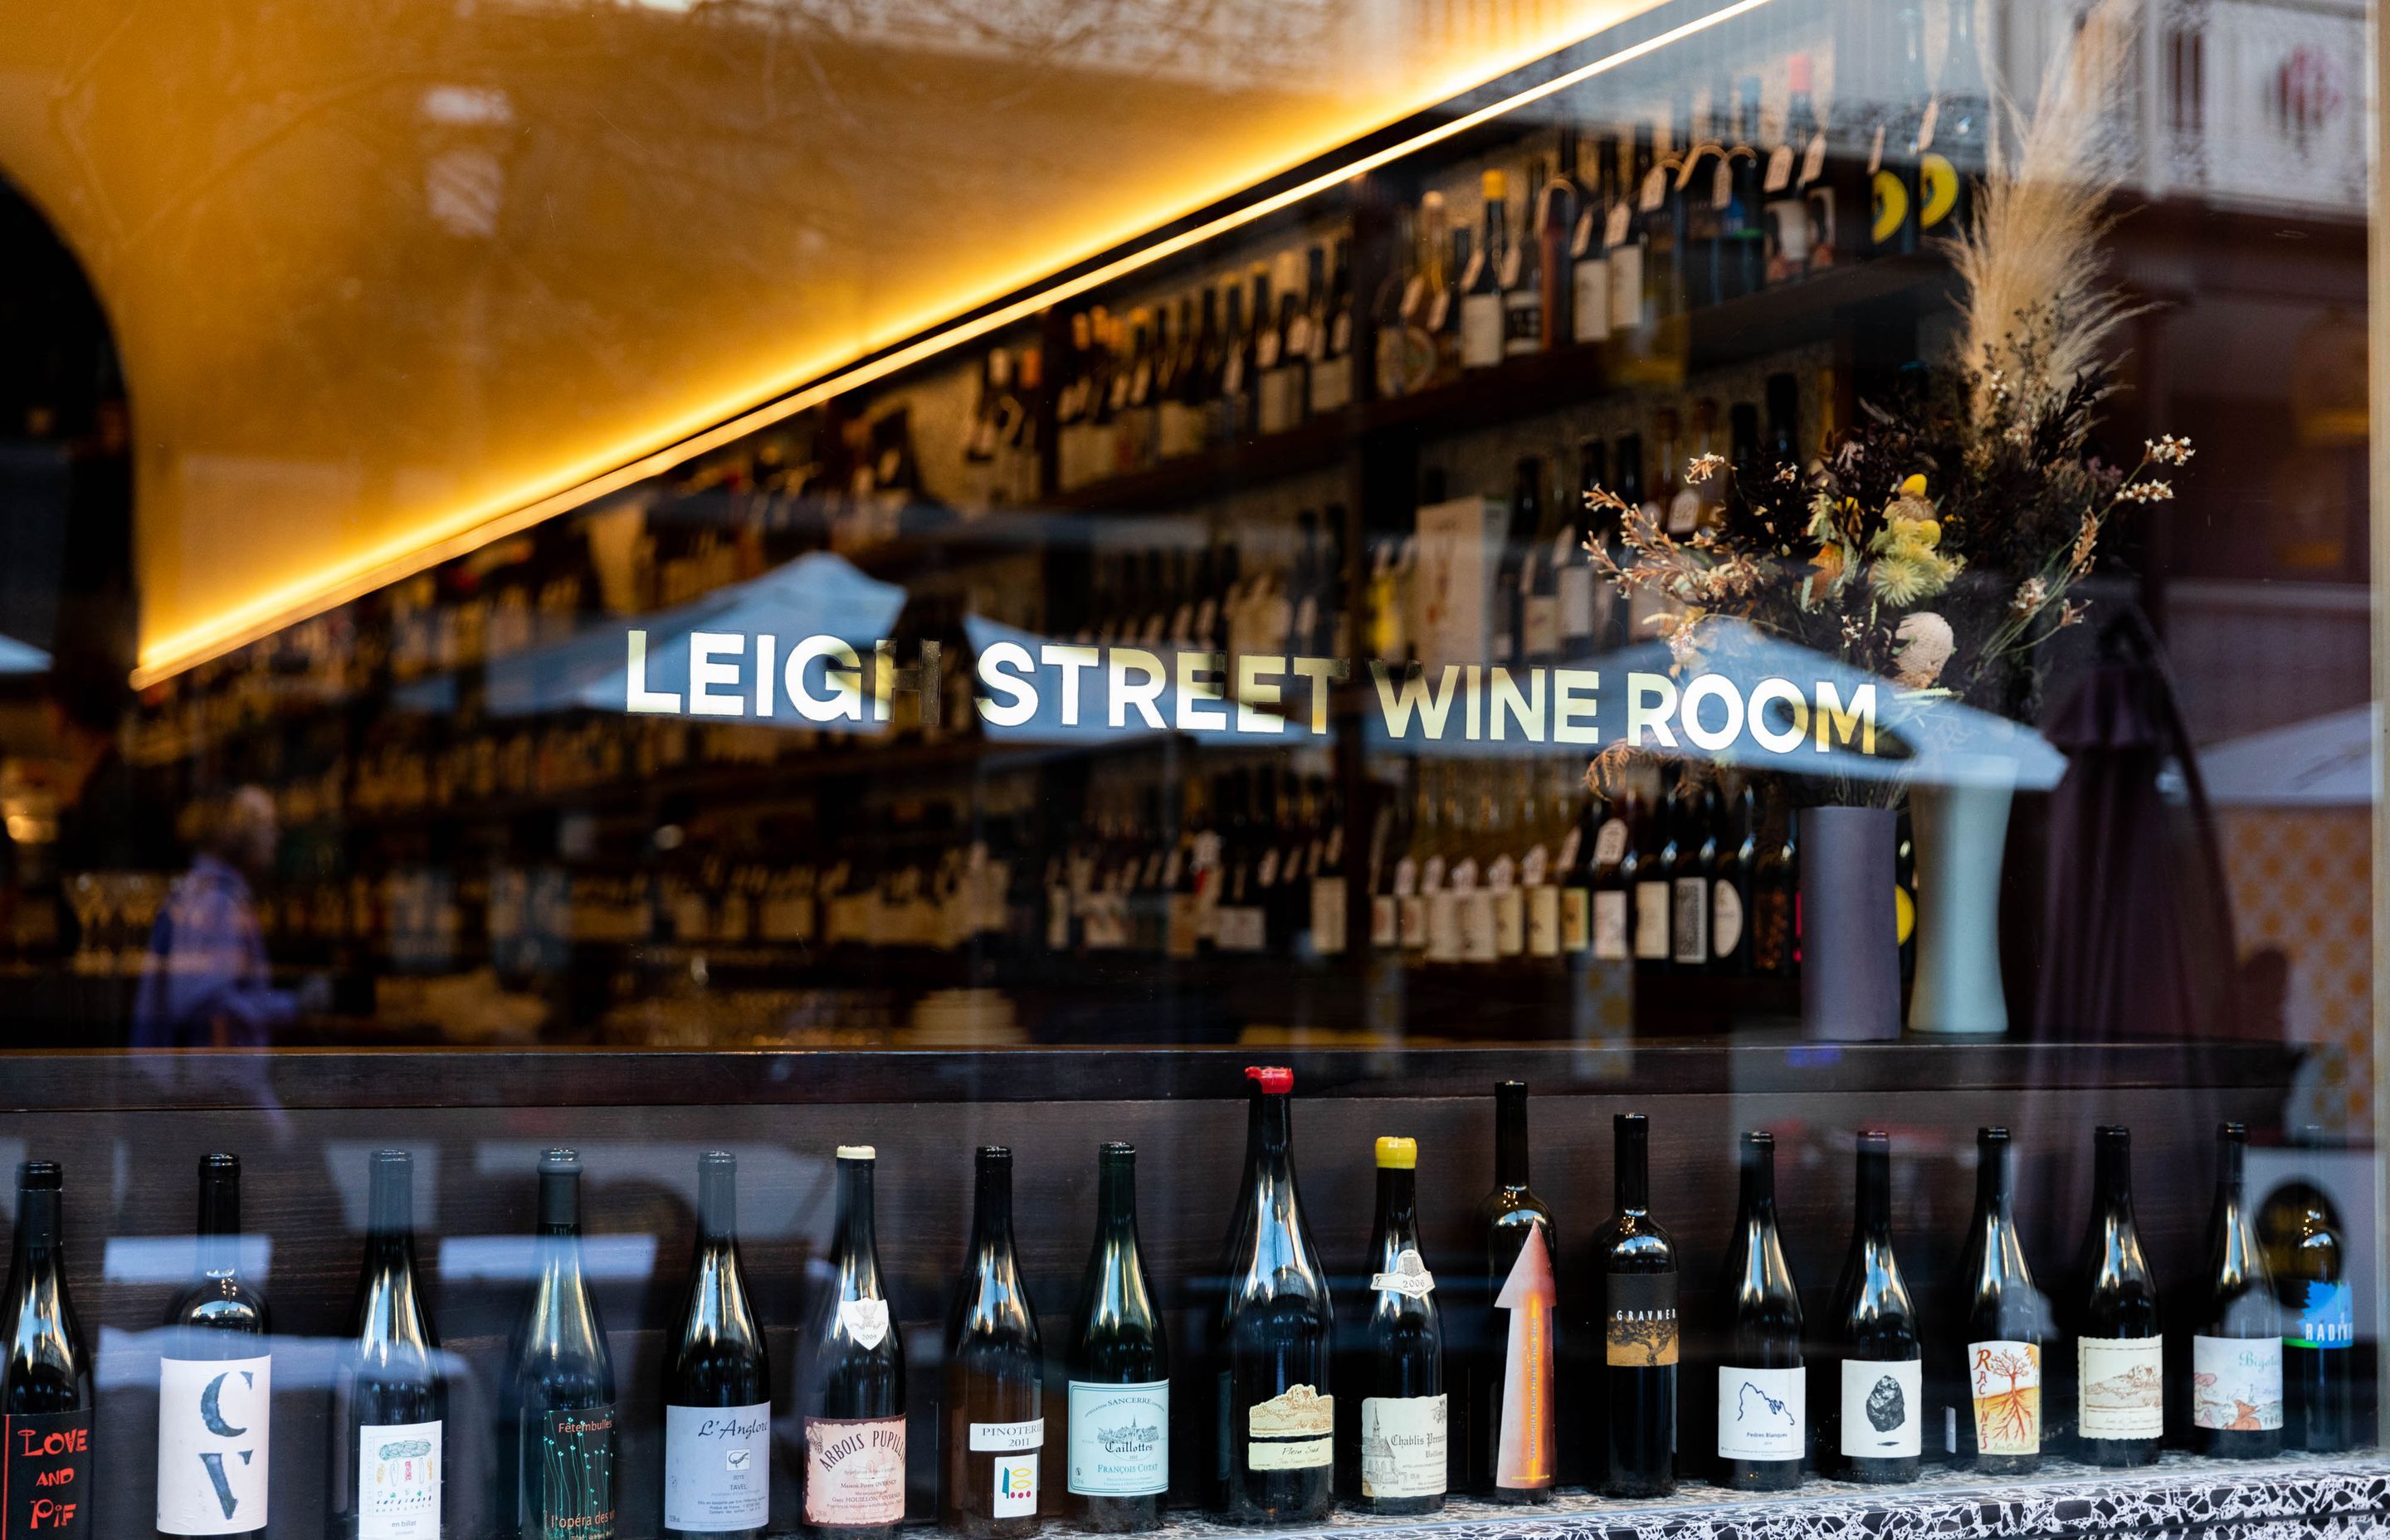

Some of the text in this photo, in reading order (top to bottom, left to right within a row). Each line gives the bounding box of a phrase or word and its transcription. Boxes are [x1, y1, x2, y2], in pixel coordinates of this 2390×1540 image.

[625, 629, 1876, 755] LEIGH STREET WINE ROOM
[1402, 1279, 1425, 1289] 2006
[1616, 1308, 1676, 1321] GRAVNER
[1107, 1396, 1152, 1406] SANCERRE
[1009, 1438, 1030, 1447] 2011
[1105, 1440, 1153, 1453] Caillottes
[1391, 1434, 1425, 1449] Chablis
[819, 1433, 865, 1472] ARBOIS
[36, 1468, 75, 1487] AND
[551, 1513, 593, 1530] l'opéra
[594, 1511, 609, 1525] des
